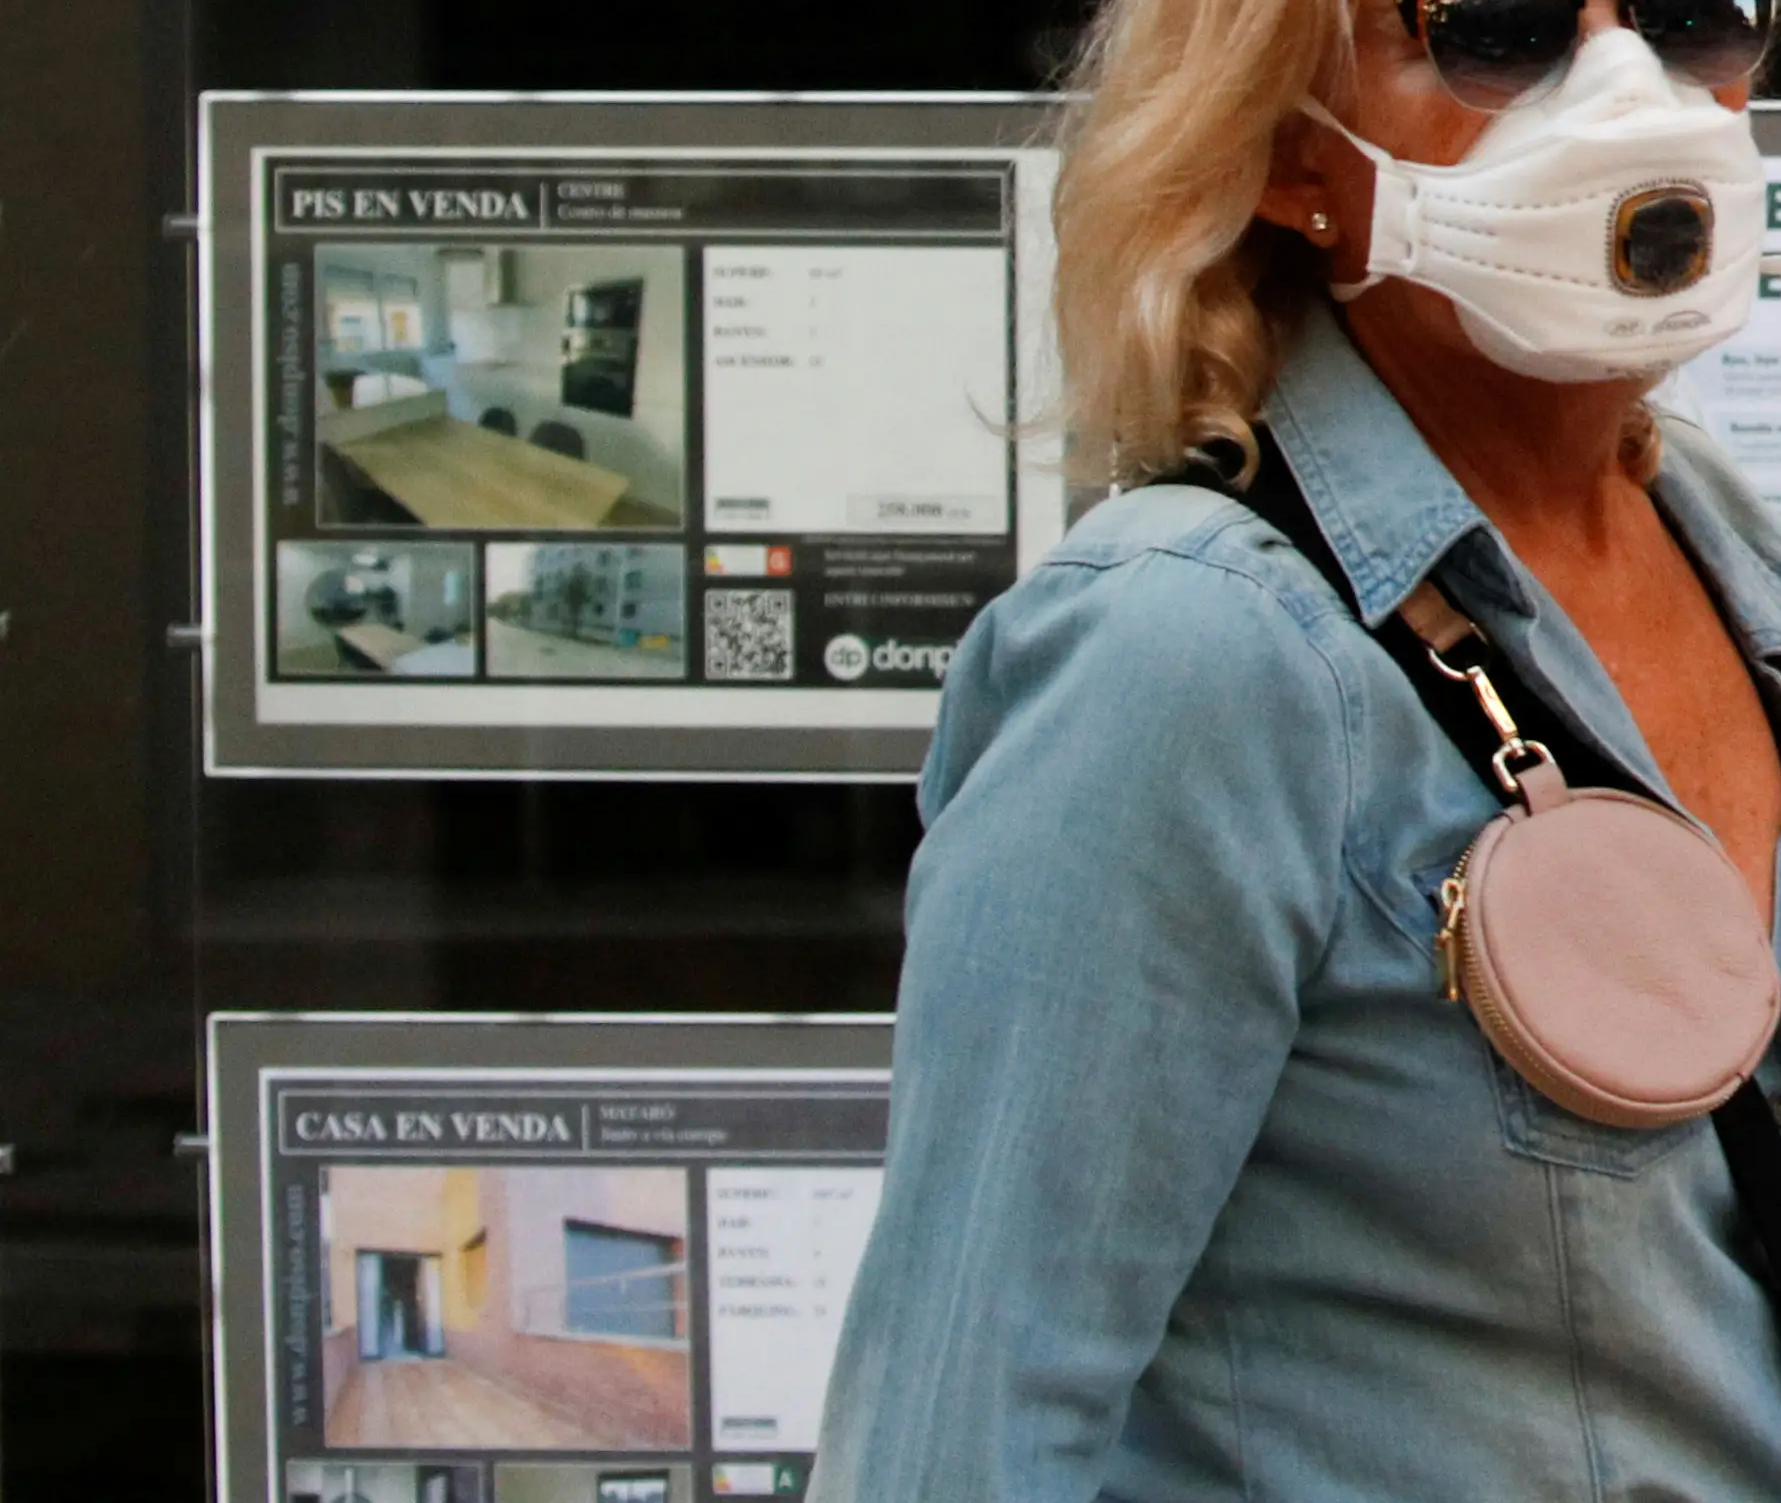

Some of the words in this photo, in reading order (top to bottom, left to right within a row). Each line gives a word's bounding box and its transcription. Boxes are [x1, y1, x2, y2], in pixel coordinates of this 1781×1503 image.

[293, 190, 346, 218] PIS
[353, 190, 399, 219] EN
[409, 190, 529, 220] VENDA
[295, 1113, 387, 1140] CASA
[396, 1112, 443, 1141] EN
[451, 1112, 570, 1142] VENDA
